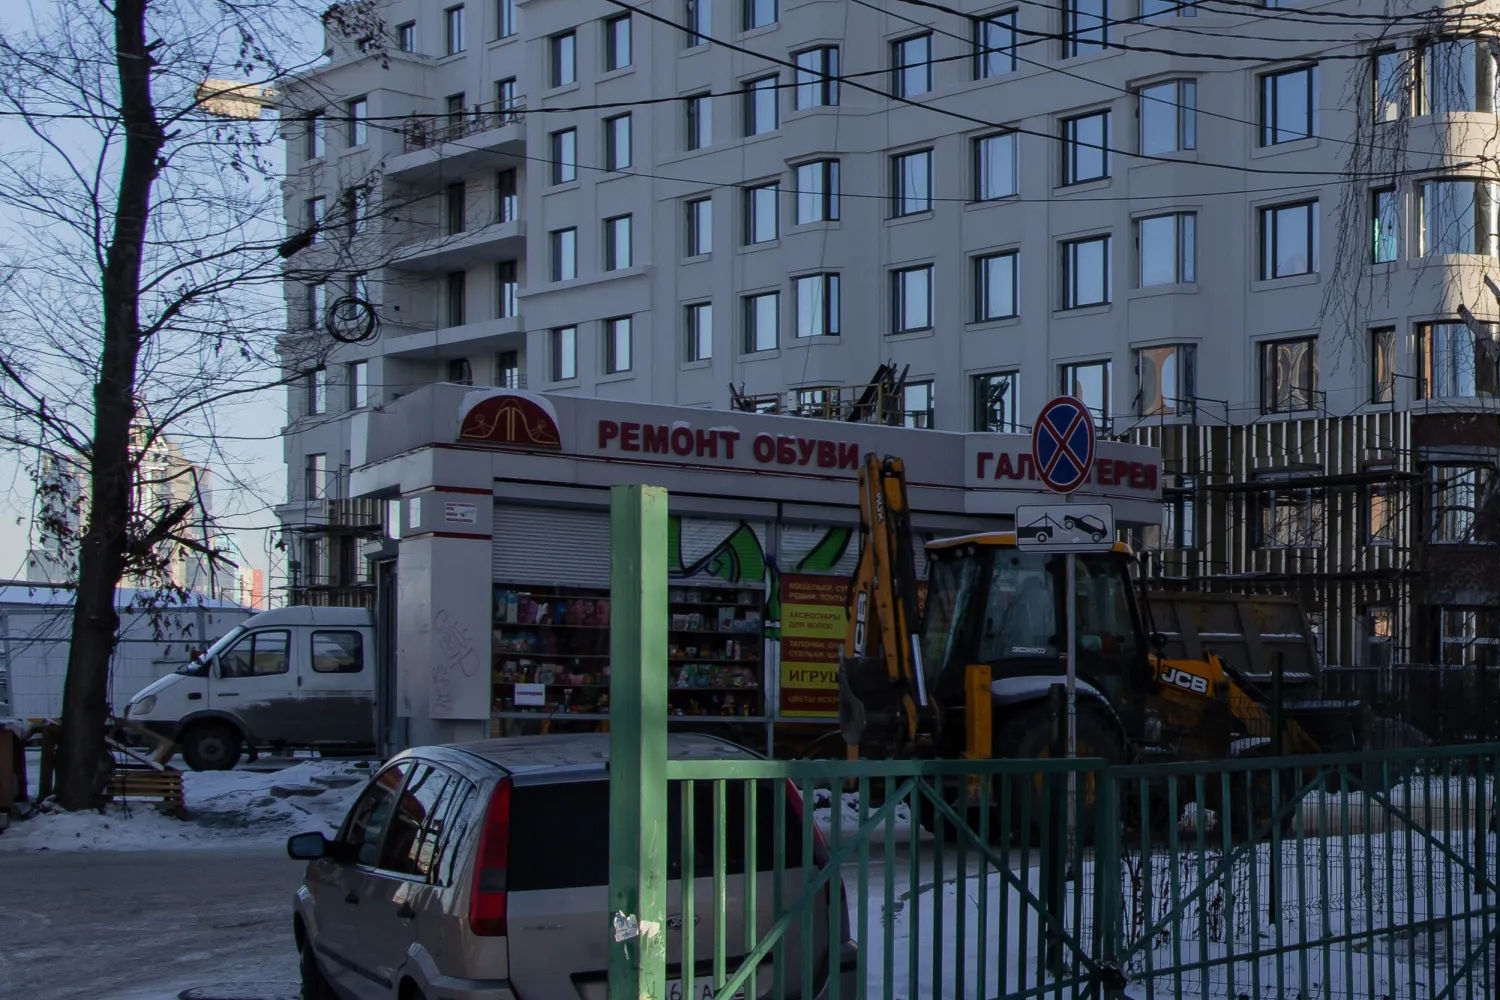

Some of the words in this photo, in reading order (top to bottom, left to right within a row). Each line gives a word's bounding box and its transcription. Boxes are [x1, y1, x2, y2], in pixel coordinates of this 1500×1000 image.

[598, 420, 740, 459] РЕМОНТ
[753, 434, 859, 469] ОБУВИ
[977, 452, 1157, 490] ГАЛЕРЕЯ
[789, 669, 838, 683] ИГРУШ
[1161, 667, 1207, 692] JCB
